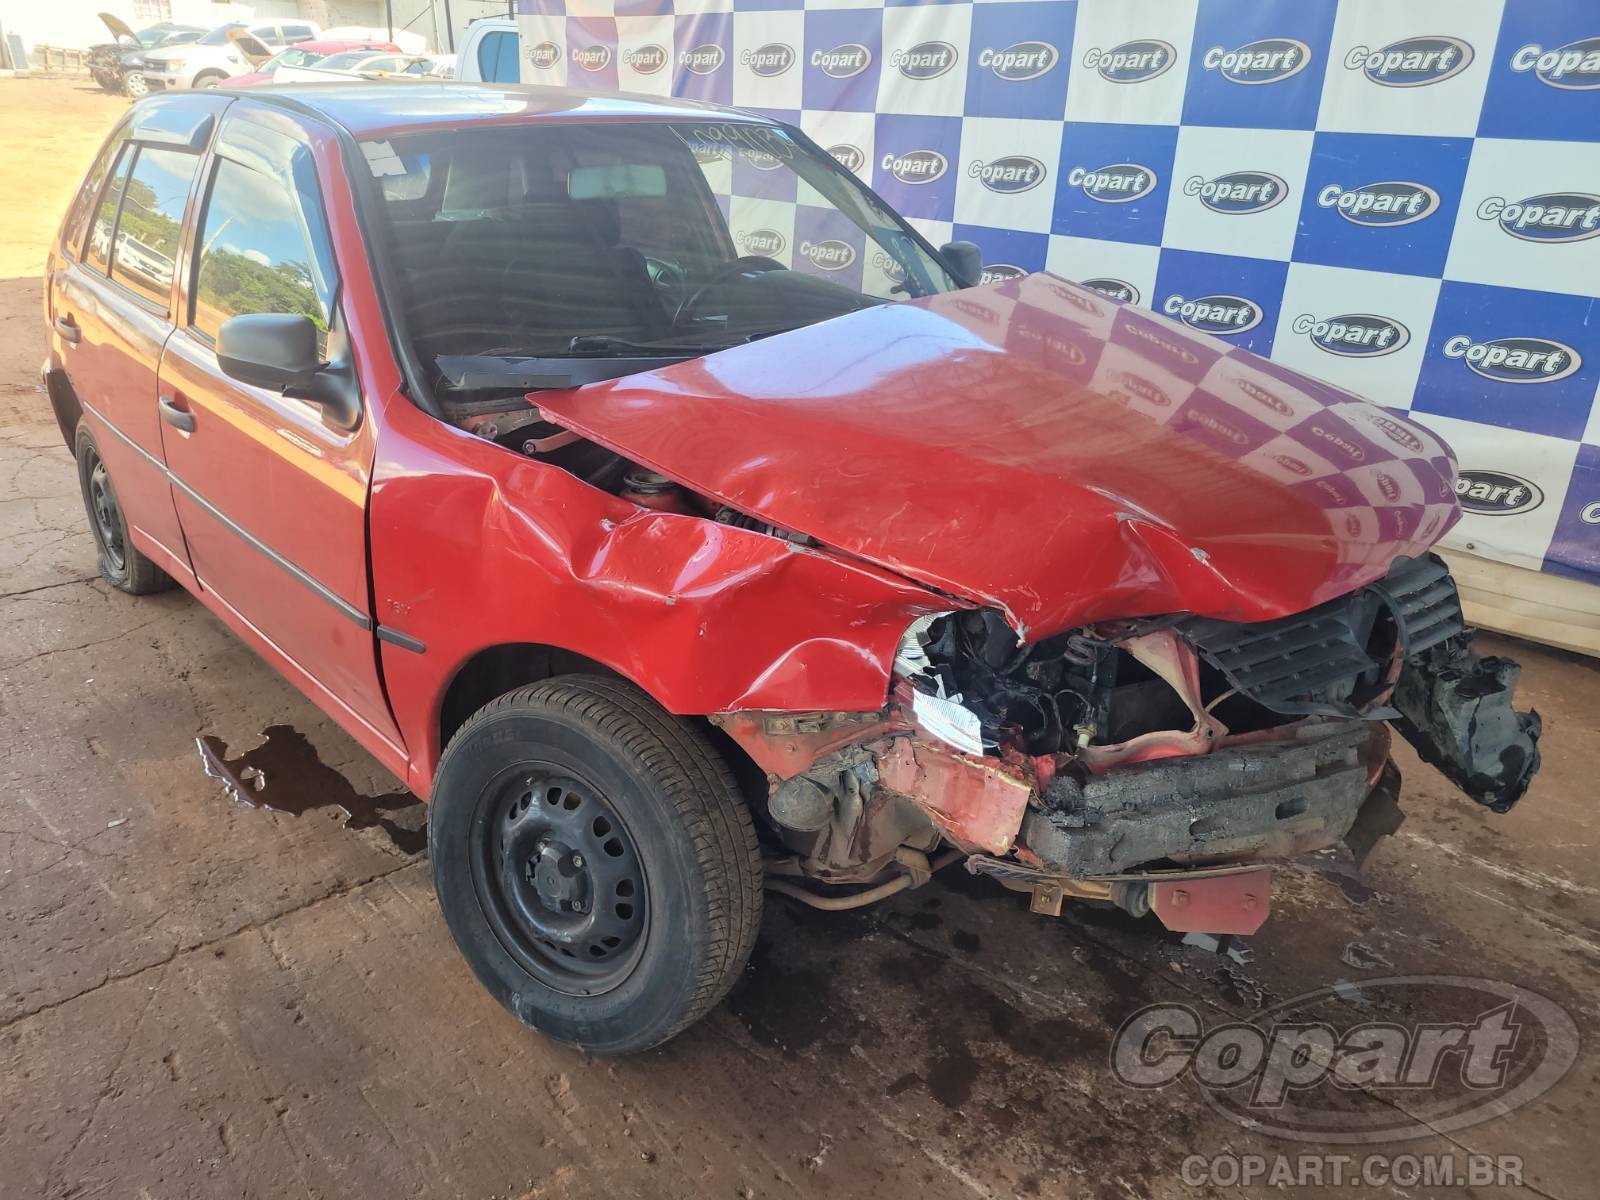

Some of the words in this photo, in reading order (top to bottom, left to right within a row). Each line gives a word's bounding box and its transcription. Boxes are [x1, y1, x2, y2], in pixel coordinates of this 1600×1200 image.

[572, 48, 605, 63] Copart
[623, 48, 661, 66] Copart
[679, 50, 719, 67] Copart
[740, 49, 787, 69] Copart
[811, 49, 864, 69] Copart
[889, 47, 949, 73] Copart
[978, 47, 1049, 73] Copart
[1083, 47, 1170, 75] Copart
[1203, 46, 1298, 76] Copart
[1344, 45, 1457, 77] Copart
[1511, 44, 1600, 79] Copa
[881, 153, 938, 177] Copart
[968, 160, 1036, 188] Copart
[1068, 167, 1146, 195] Copart
[1184, 175, 1274, 204] Copart
[1318, 184, 1425, 215] Copart
[1477, 196, 1600, 230] Copart
[736, 231, 780, 251] Copart
[800, 241, 849, 261] Copart
[872, 251, 904, 275] Cop
[1163, 293, 1252, 327] Copart
[1292, 313, 1397, 348] Copart
[1443, 335, 1567, 374] Copart
[1454, 478, 1527, 507] part
